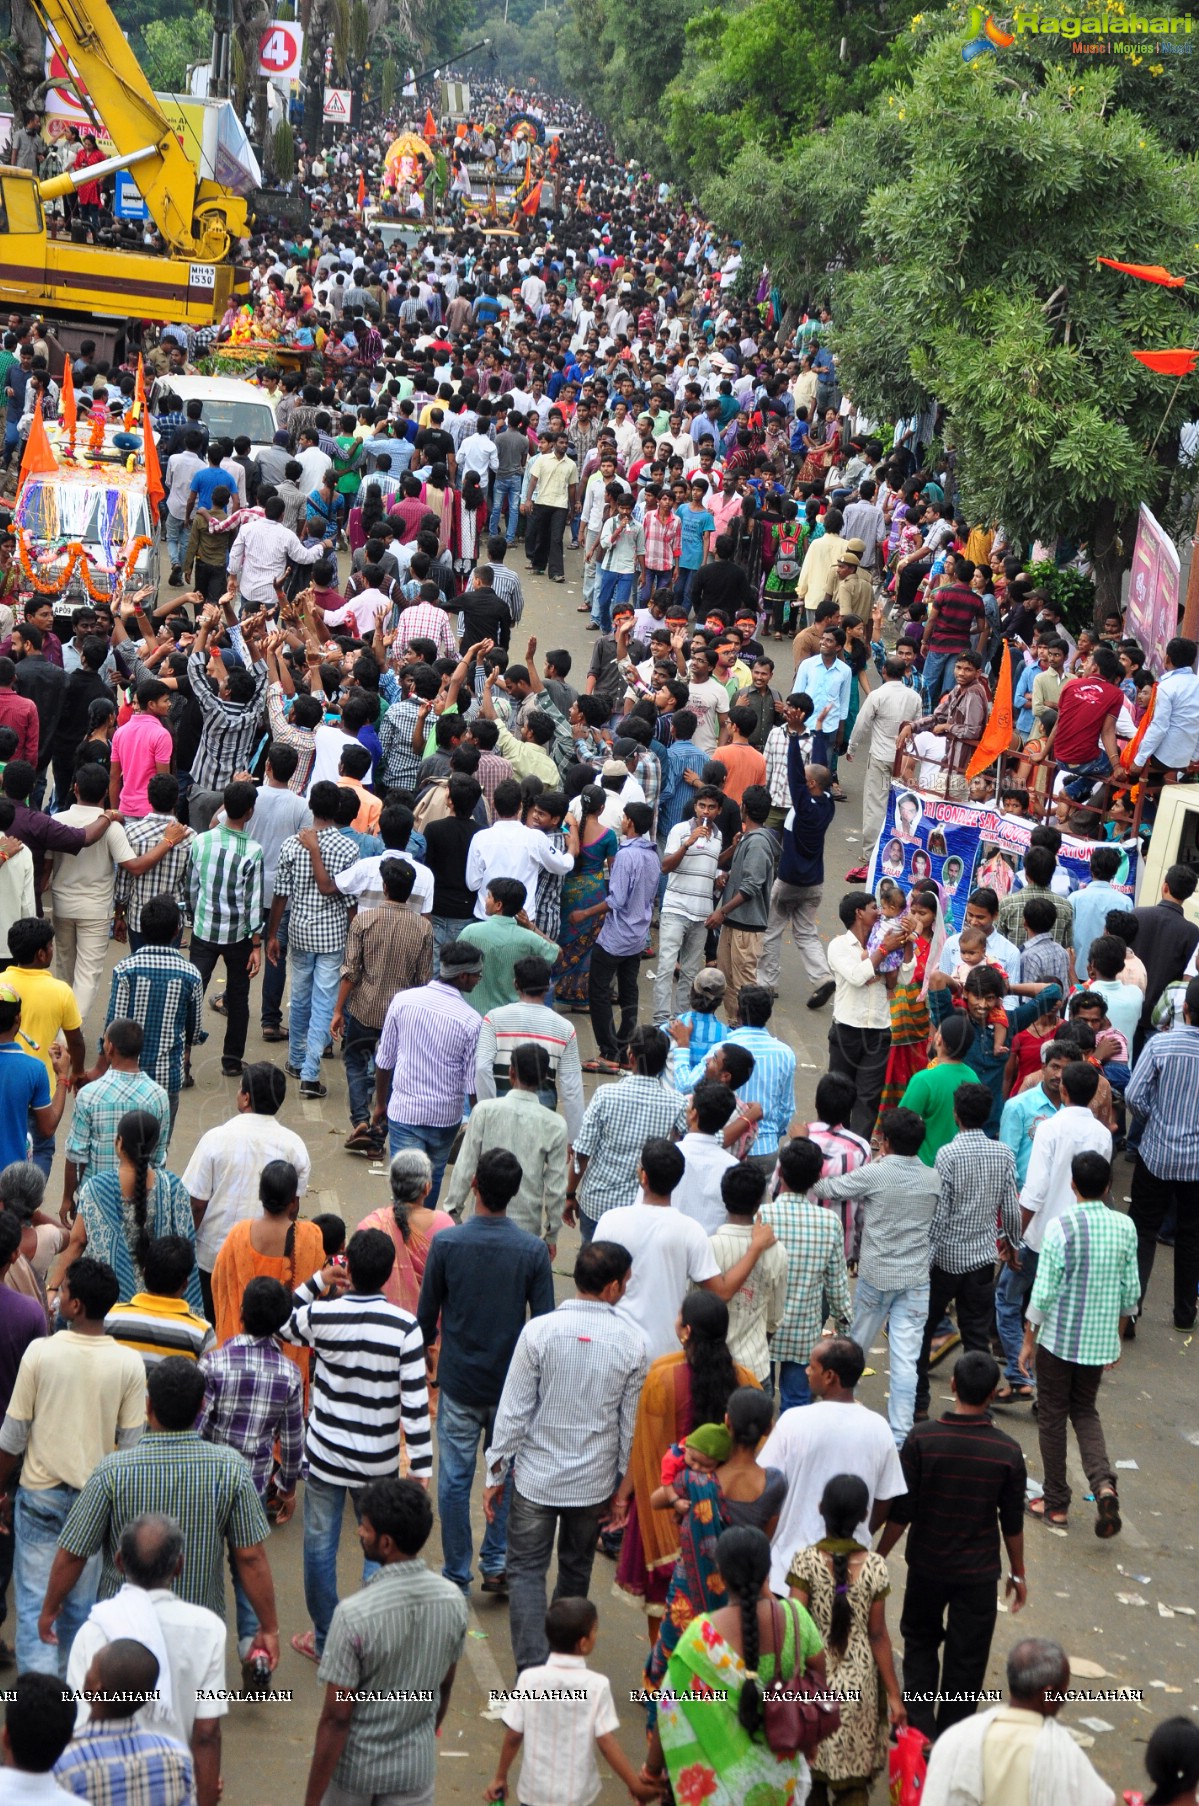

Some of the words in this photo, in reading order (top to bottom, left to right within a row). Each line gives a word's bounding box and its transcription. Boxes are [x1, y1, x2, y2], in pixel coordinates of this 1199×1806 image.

[262, 30, 289, 66] 4
[191, 266, 215, 276] MH43
[191, 275, 213, 285] 1530
